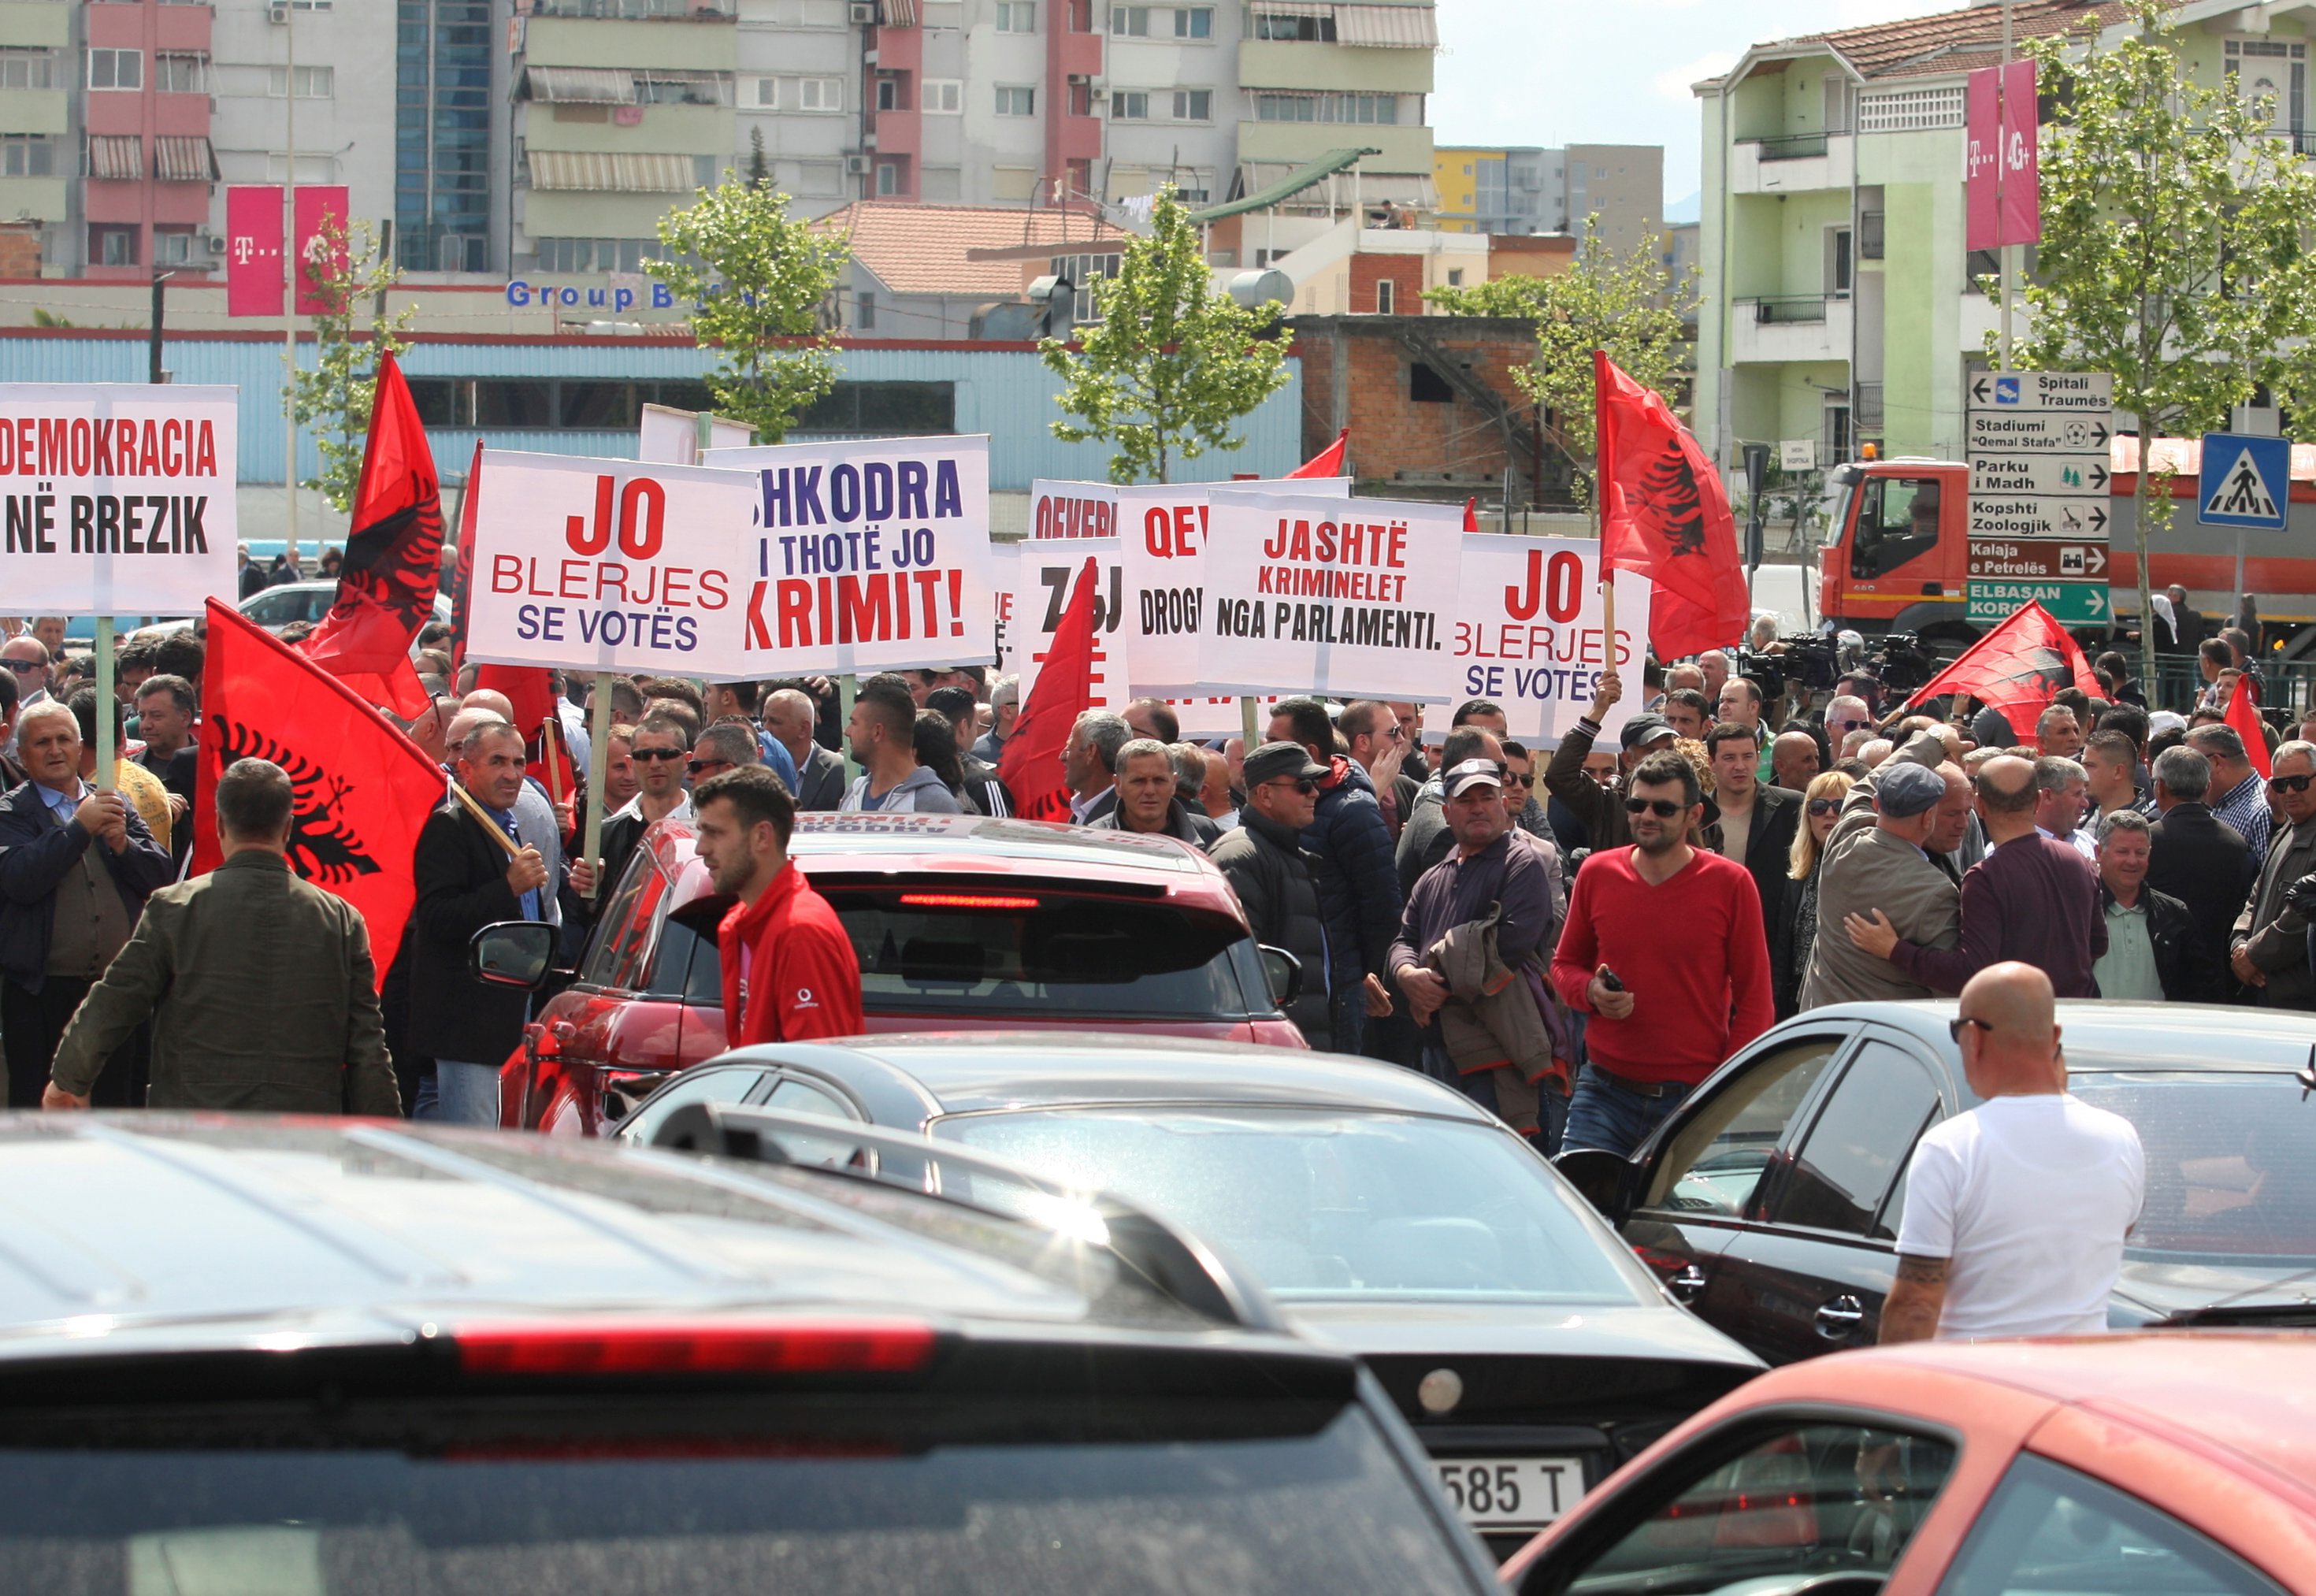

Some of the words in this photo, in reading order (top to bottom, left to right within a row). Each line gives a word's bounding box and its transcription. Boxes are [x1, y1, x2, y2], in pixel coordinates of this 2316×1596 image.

[507, 280, 633, 313] Group
[2039, 377, 2089, 392] Spitali
[2039, 394, 2108, 407] Traumës
[1976, 419, 2046, 432] Stadiumi
[0, 418, 217, 477] DEMOKRACIA
[1976, 460, 2029, 473] Parku
[753, 459, 962, 529] HKODRA
[1975, 477, 1980, 488] i
[1987, 477, 2035, 489] Madh
[6, 482, 57, 554] NË
[71, 495, 209, 555] RREZIK
[566, 475, 666, 560] JO
[1973, 501, 2037, 516] Kopshti
[1973, 518, 2051, 534] Zoologjik
[779, 524, 881, 576] THOTË
[892, 527, 935, 568] JO
[1264, 518, 1407, 569] JASHTË
[1971, 544, 2018, 560] Kalaja
[492, 554, 729, 611] BLERJES
[1258, 564, 1406, 603] KRIMINELET
[1505, 549, 1583, 624] JO
[1971, 563, 1980, 573] e
[1984, 561, 2047, 575] Petrelës
[744, 569, 966, 651] KRIMIT!
[1970, 585, 2061, 599] ELBASAN
[517, 604, 565, 642] SE
[577, 606, 698, 651] VOTËS
[1216, 597, 1266, 639] NGA
[1274, 601, 1442, 651] PARLAMENTI.
[1466, 665, 1505, 697] SE
[1540, 1465, 1565, 1512] T
